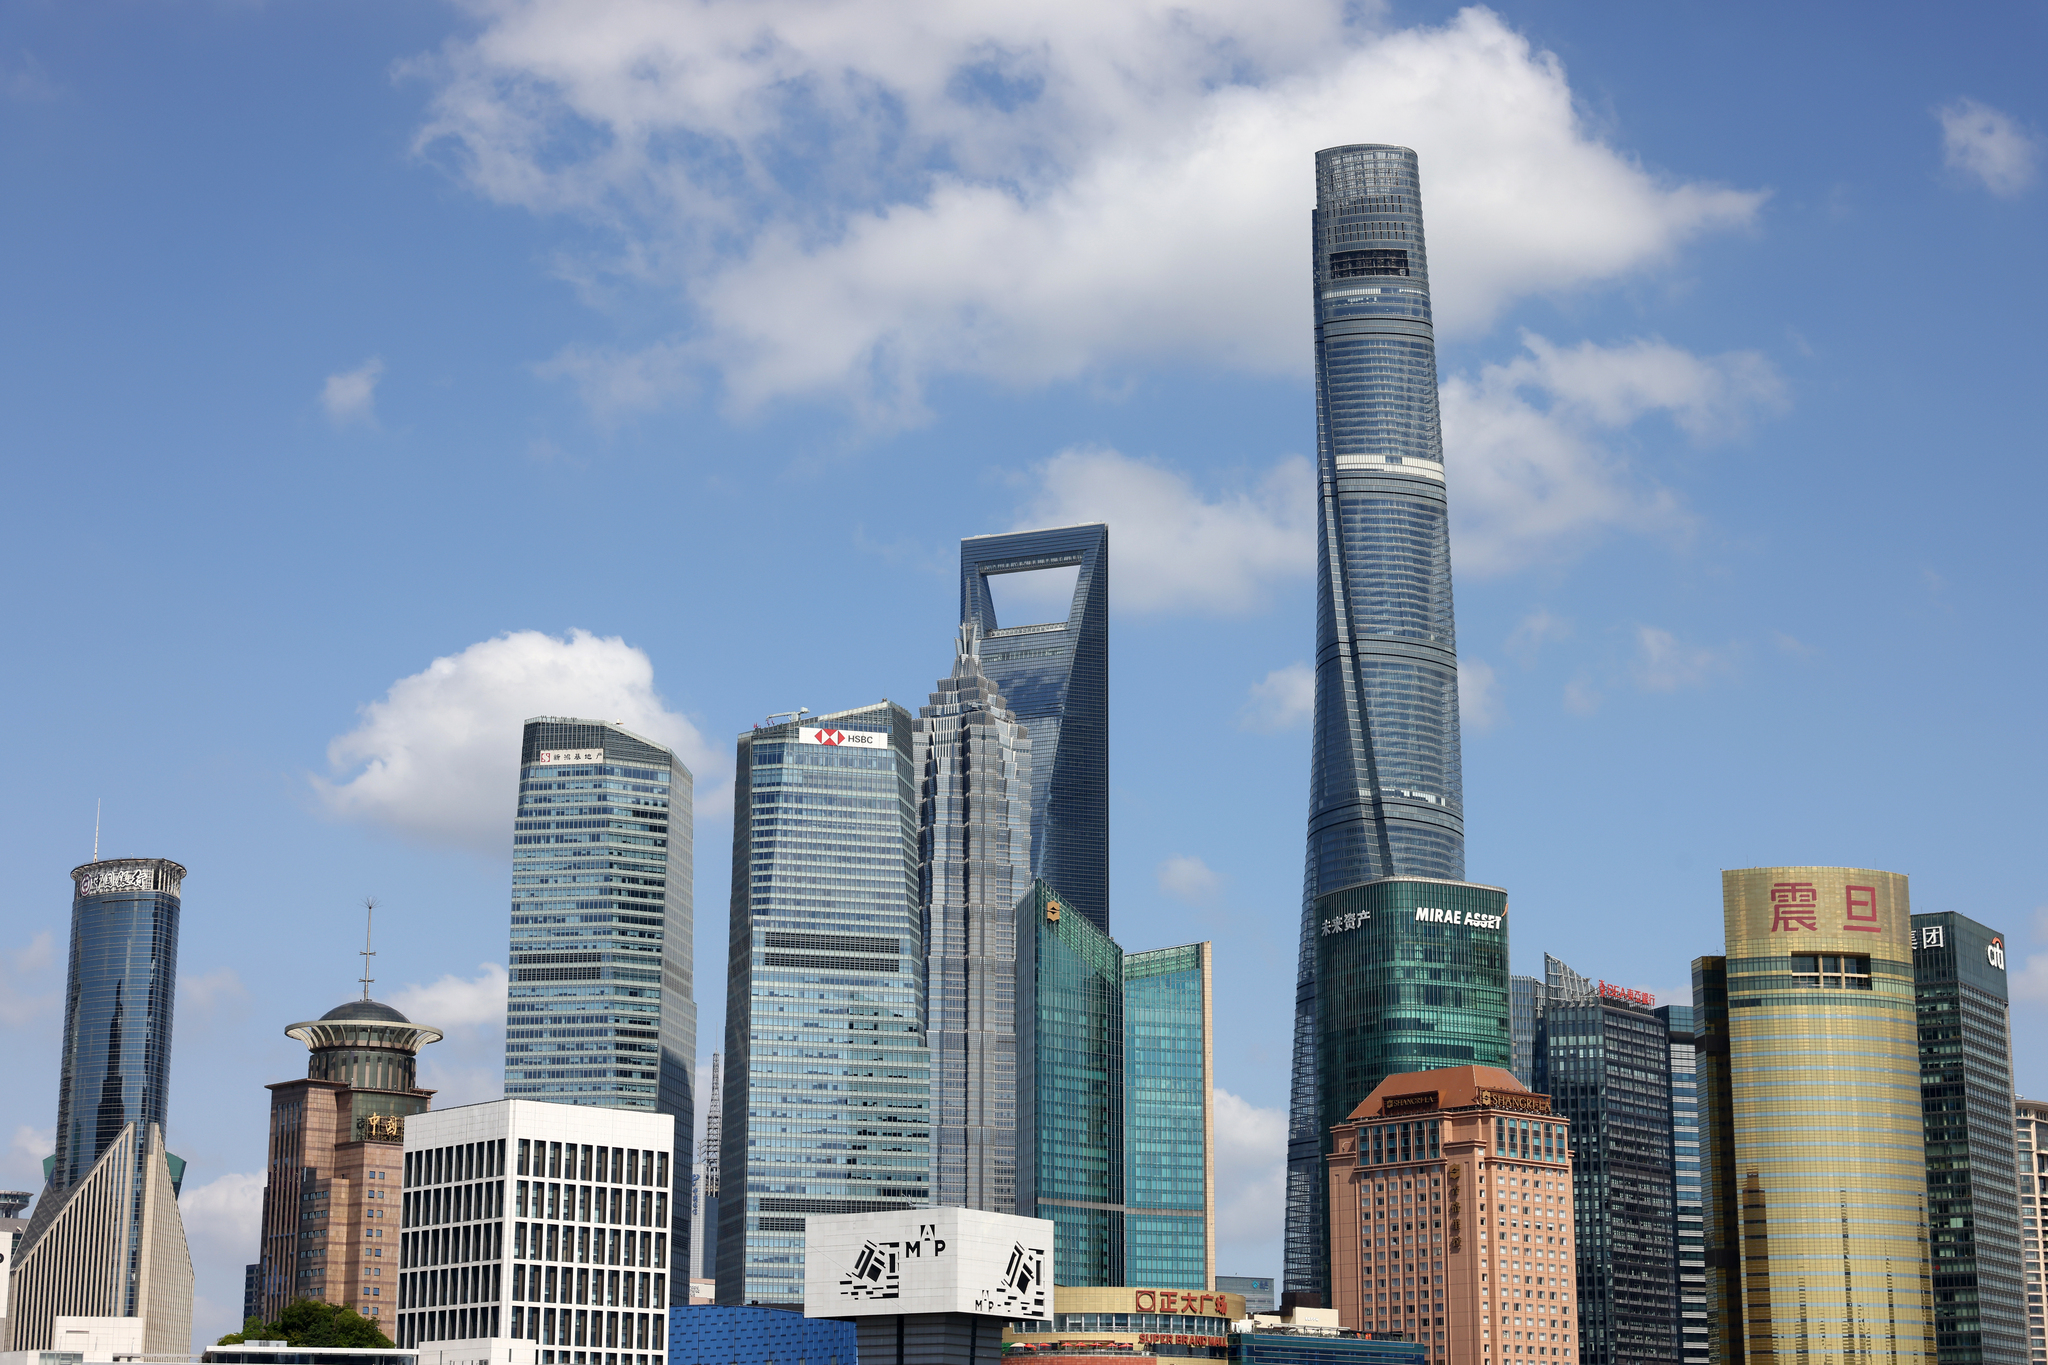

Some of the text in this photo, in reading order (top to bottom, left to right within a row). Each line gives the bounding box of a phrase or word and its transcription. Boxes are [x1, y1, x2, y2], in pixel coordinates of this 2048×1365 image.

[848, 735, 873, 744] HSBC
[1415, 907, 1502, 929] MIRAE ASSET
[1771, 882, 1881, 933] 震旦
[1321, 909, 1371, 937] 未来资产
[1987, 941, 2005, 971] citi
[1607, 983, 1626, 999] BEA
[1492, 1093, 1551, 1112] SHANGRI-LA
[1160, 1291, 1228, 1316] 正大广场
[1139, 1333, 1228, 1347] SUPER BRAND MALL
